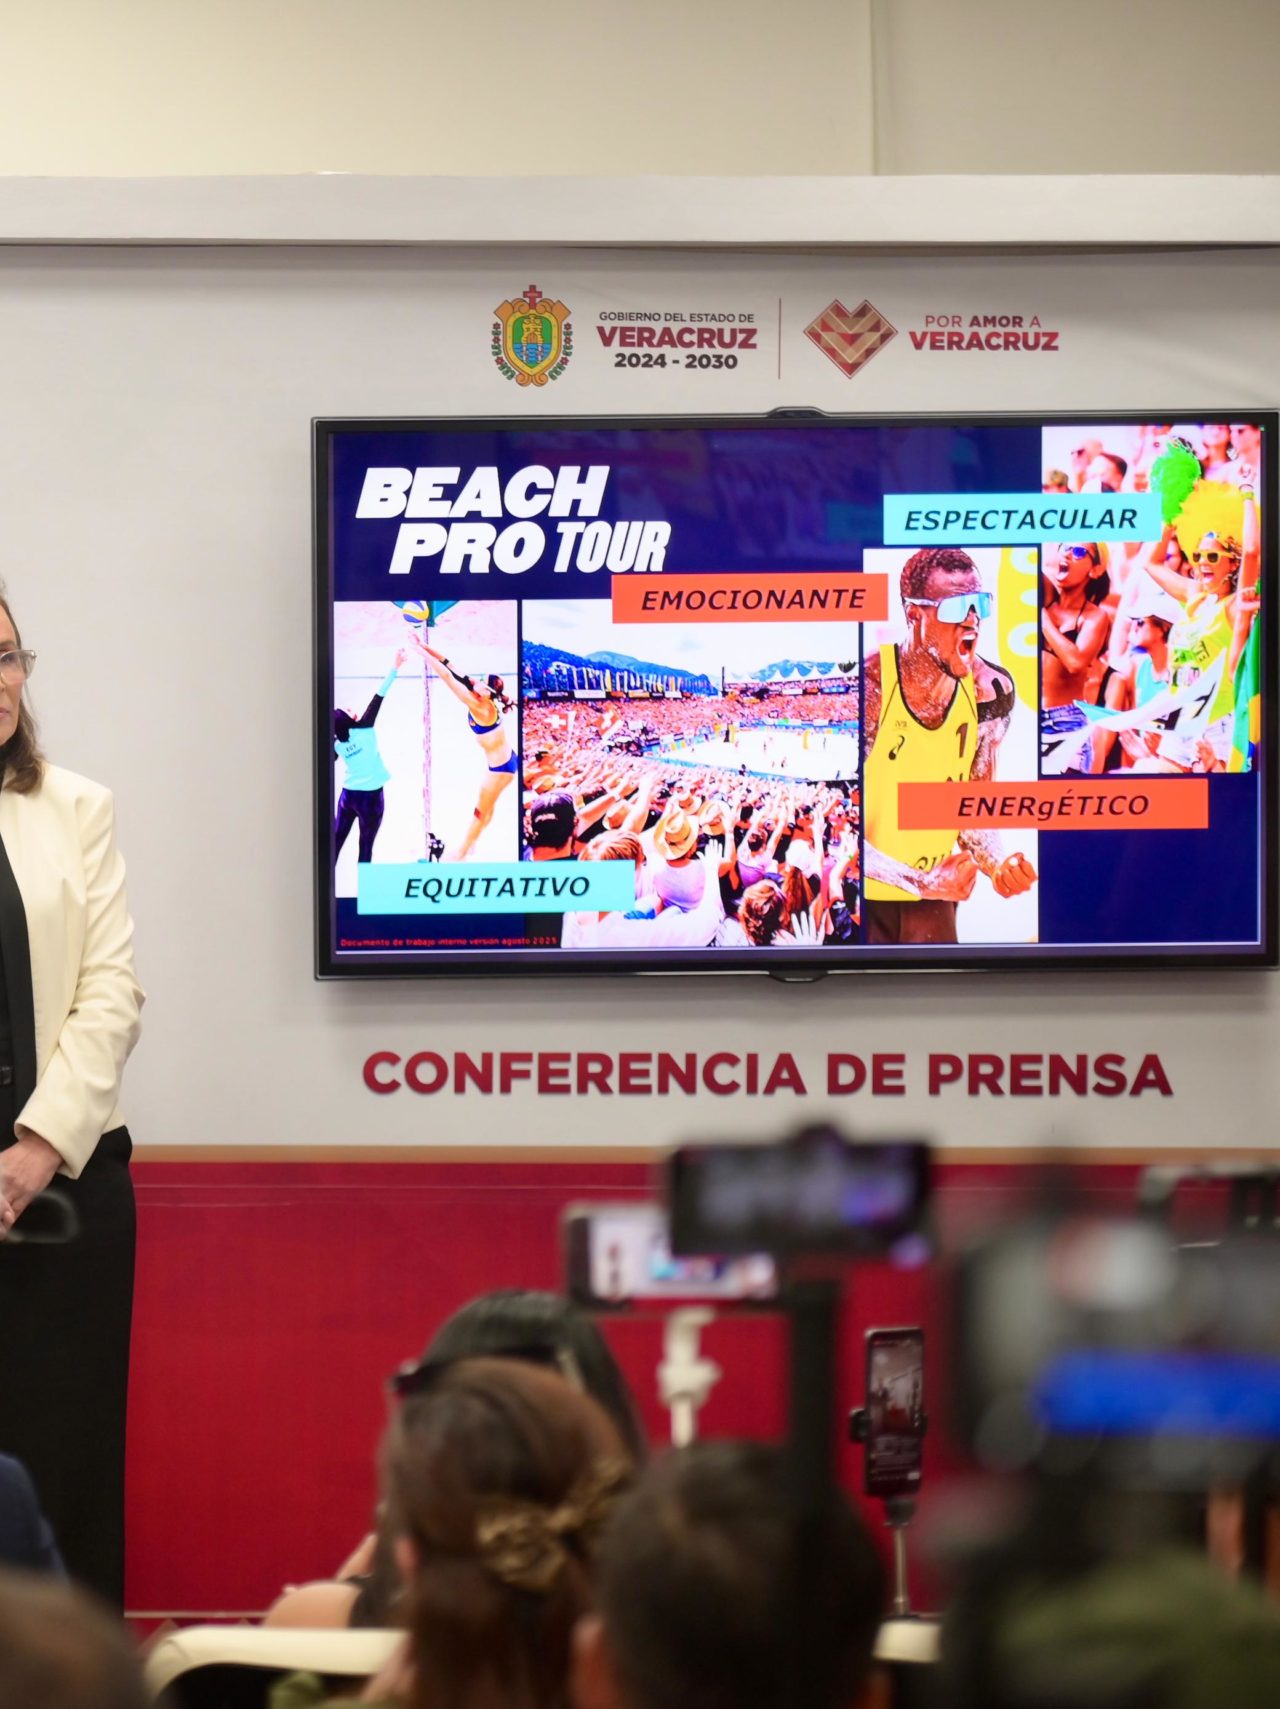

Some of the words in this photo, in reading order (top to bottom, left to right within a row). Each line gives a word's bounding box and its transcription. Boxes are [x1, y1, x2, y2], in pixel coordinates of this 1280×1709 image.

[599, 311, 661, 322] GOBIERNO
[664, 312, 687, 322] DEL
[689, 313, 736, 323] ESTADO
[738, 313, 755, 323] DE
[925, 315, 962, 328] POR
[969, 315, 1023, 328] AMOR
[1029, 315, 1041, 328] A
[596, 326, 757, 349] VERACRUZ
[908, 331, 1059, 351] VERACRUZ
[614, 353, 667, 368] 2024
[684, 354, 738, 369] 2030
[355, 465, 611, 519] BEACH
[904, 508, 1138, 531] ESPECTACULAR
[388, 521, 546, 574] PRO
[553, 521, 672, 573] TOUR
[641, 588, 867, 611] EMOCIONANTE
[957, 788, 1149, 822] ENERgÉTICO
[405, 876, 590, 902] EQUITATIVO
[340, 938, 390, 947] Documento
[392, 938, 403, 946] de
[405, 938, 436, 947] trabajo
[437, 938, 467, 946] interno
[501, 937, 531, 946] agosto
[363, 1051, 808, 1095] CONFERENCIA
[826, 1053, 906, 1094] DE
[927, 1053, 1174, 1097] PRENSA
